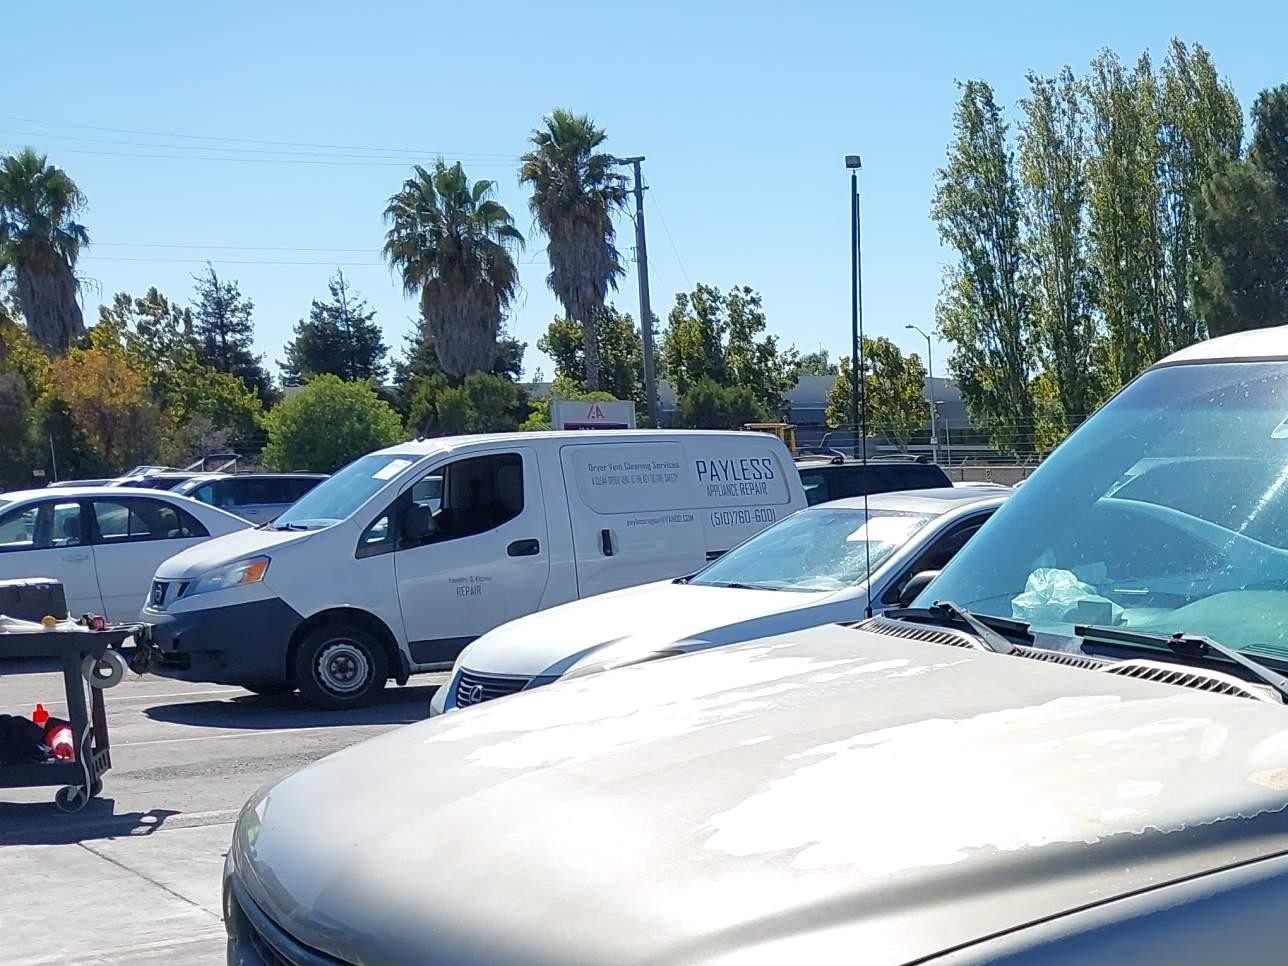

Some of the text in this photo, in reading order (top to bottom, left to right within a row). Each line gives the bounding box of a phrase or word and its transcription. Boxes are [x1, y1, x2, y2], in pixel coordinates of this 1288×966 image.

[696, 458, 775, 483] PAYLESS
[706, 481, 768, 496] APPLIANCE REPAIR
[710, 508, 777, 527] (510)760-6001
[456, 584, 482, 597] REPAIR
